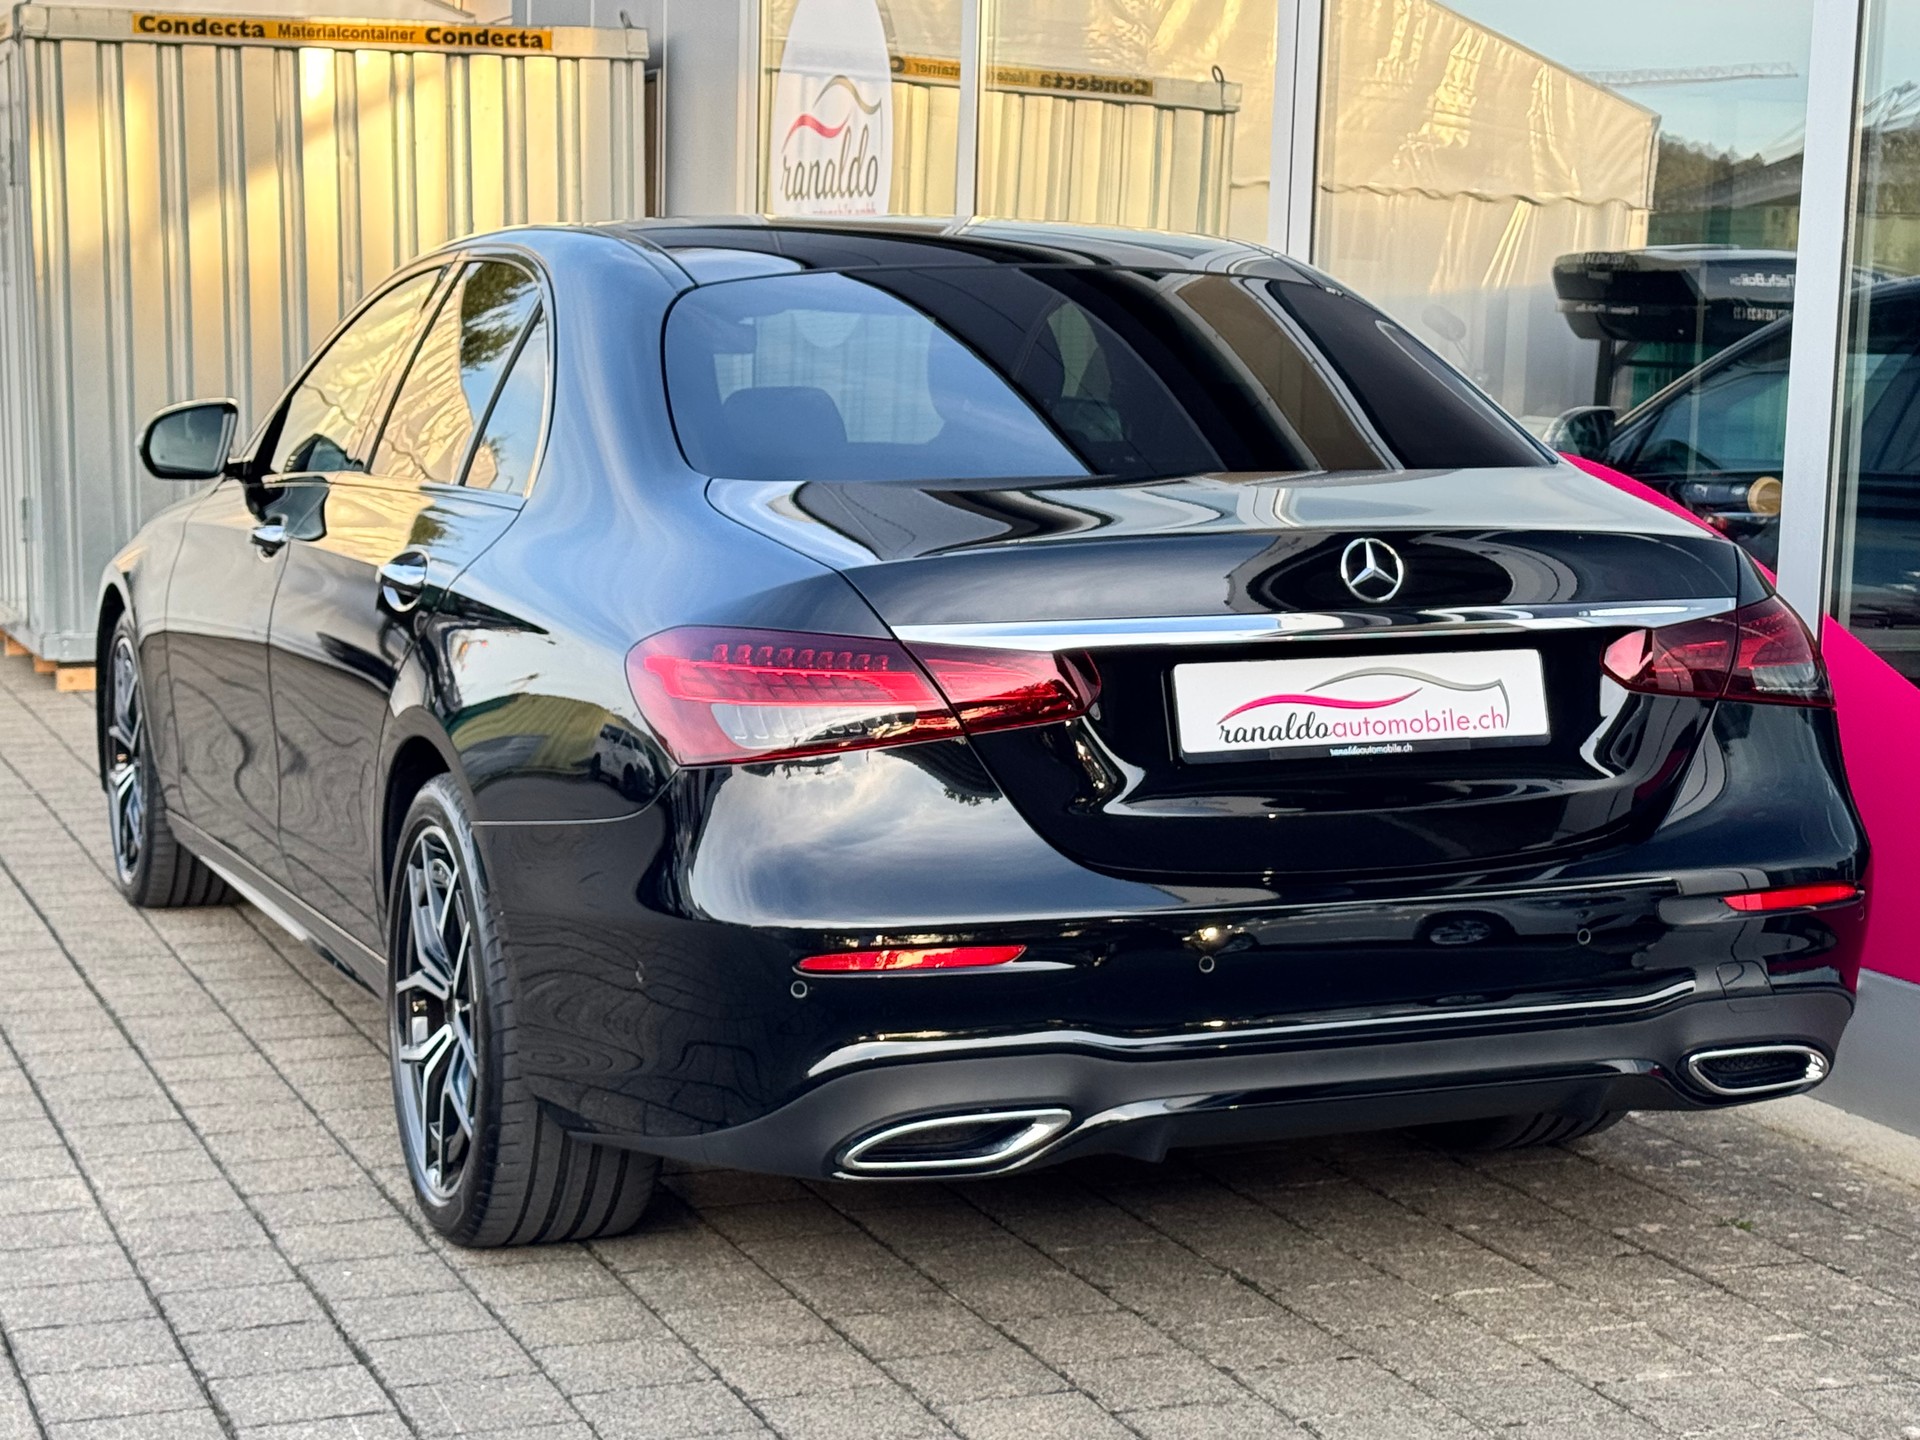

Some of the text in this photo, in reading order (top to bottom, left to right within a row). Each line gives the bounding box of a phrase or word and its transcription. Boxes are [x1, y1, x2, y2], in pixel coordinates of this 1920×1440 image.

[139, 15, 543, 49] Condecta Materialcontainer Condecta
[780, 124, 878, 201] ranaldo
[1219, 707, 1504, 743] ranaldoautomobile.ch
